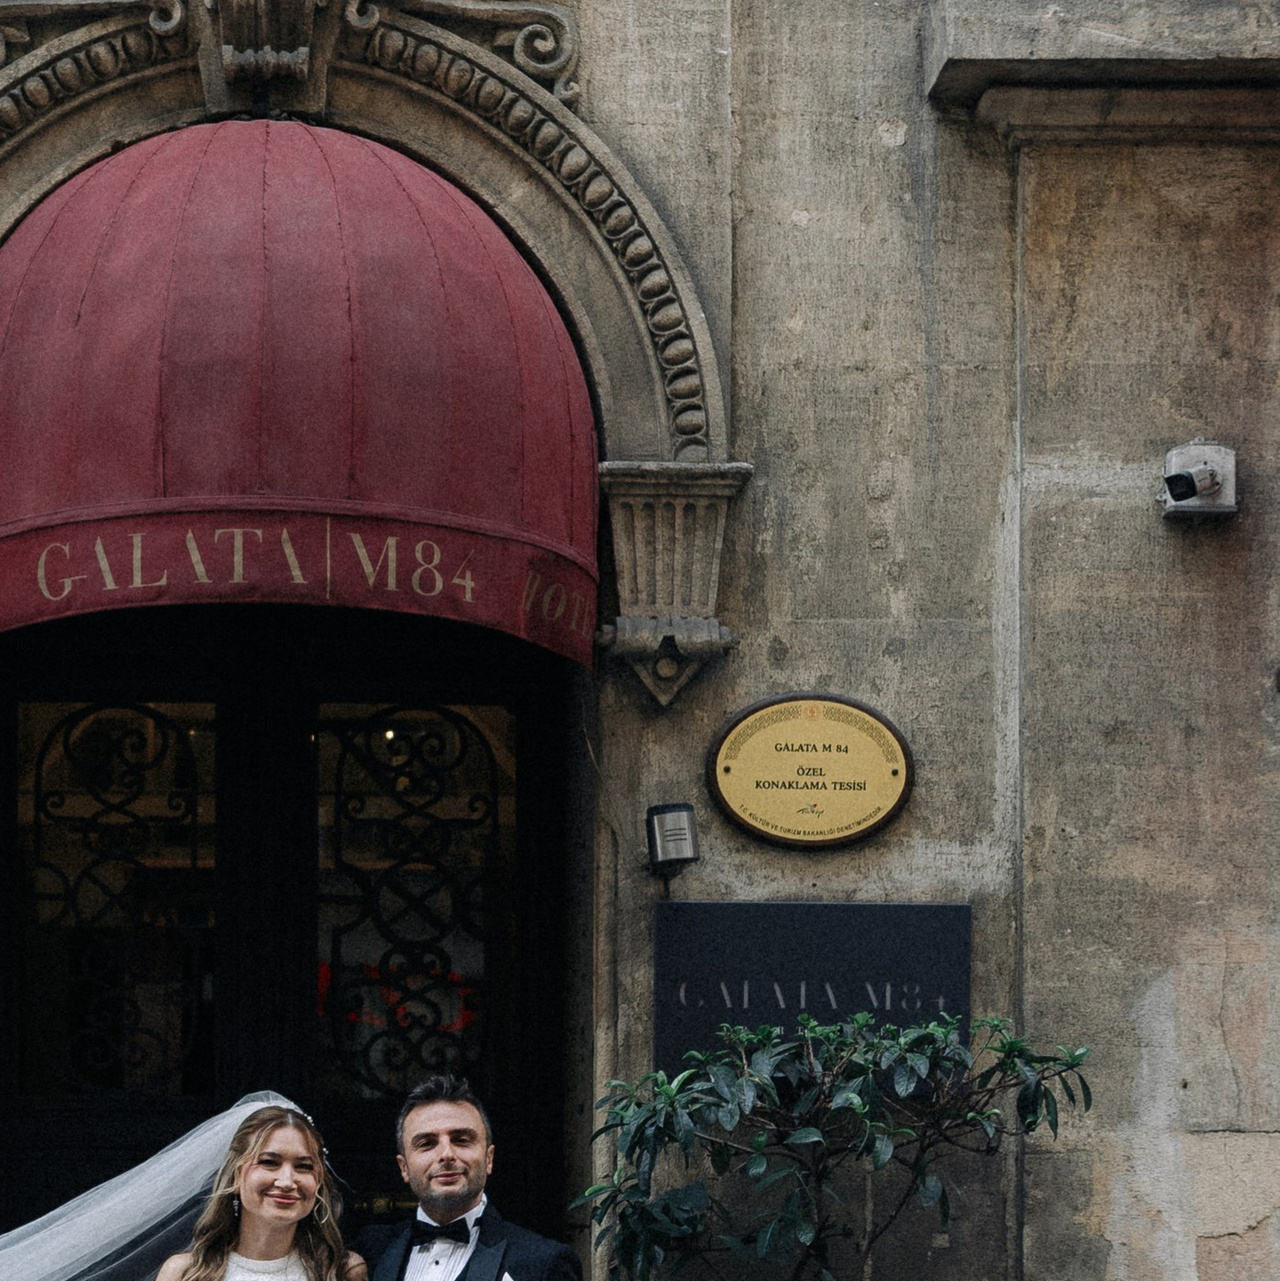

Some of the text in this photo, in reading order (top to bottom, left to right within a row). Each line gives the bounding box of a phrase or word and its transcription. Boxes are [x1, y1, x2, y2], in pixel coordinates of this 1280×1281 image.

[37, 528, 477, 604] GALATA M84
[774, 742, 849, 754] GALATA M 84
[796, 765, 826, 777] ÖZEL
[755, 779, 867, 791] KONAKLAMA TESİSİ
